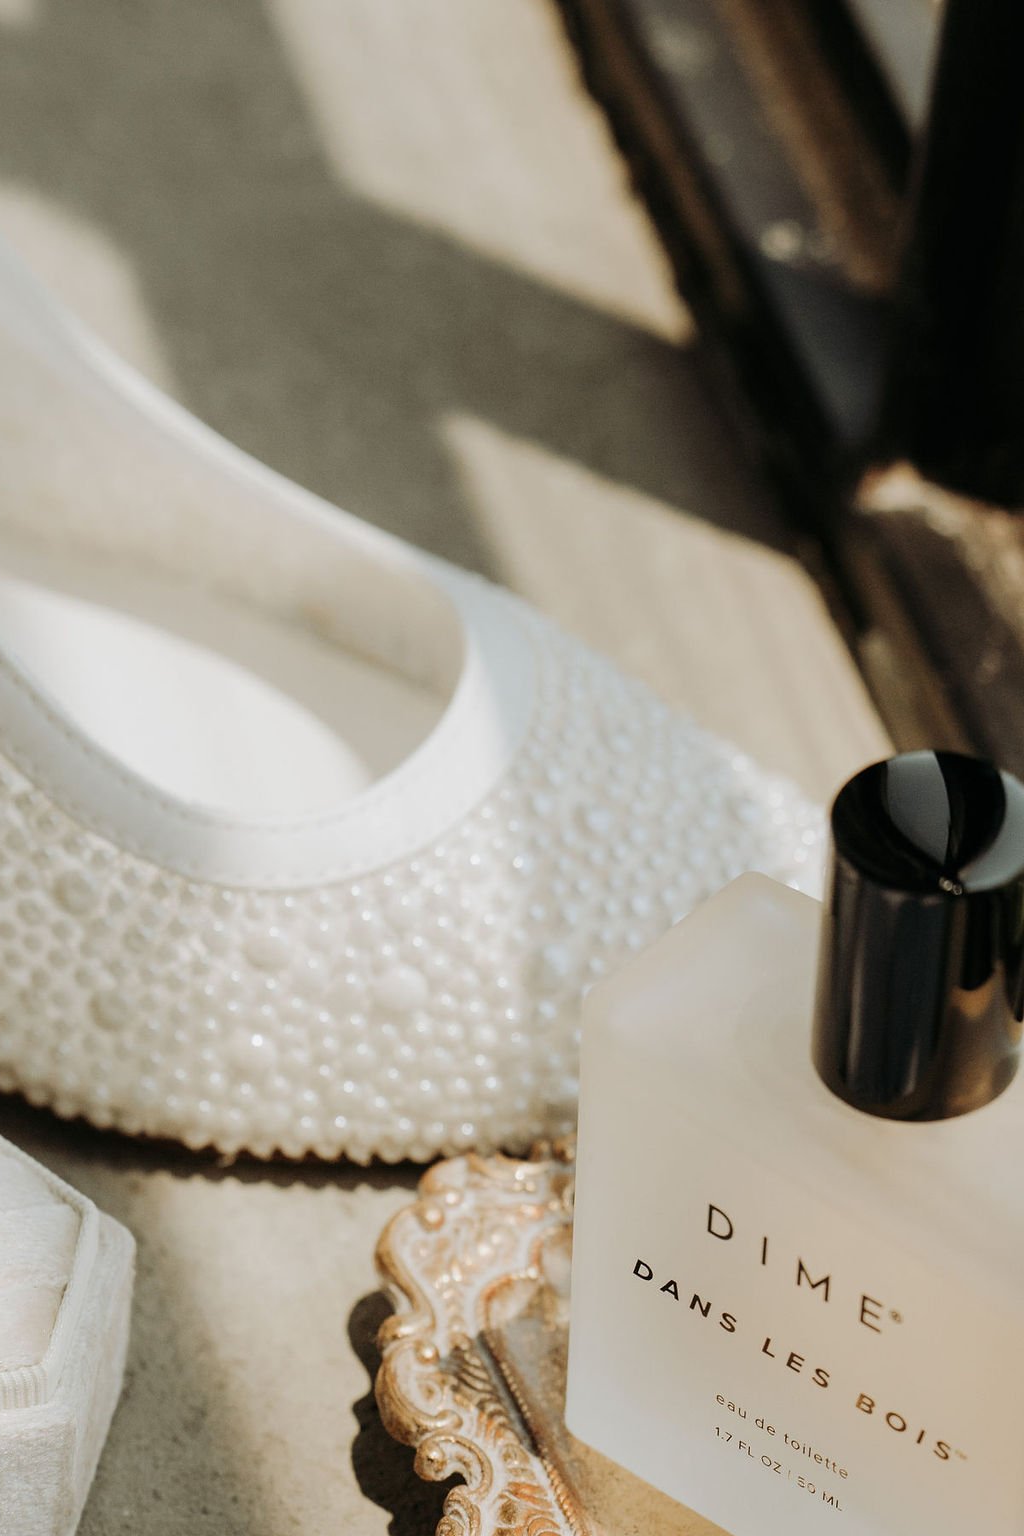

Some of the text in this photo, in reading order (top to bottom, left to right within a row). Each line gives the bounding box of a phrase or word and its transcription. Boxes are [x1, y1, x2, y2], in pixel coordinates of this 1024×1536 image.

[632, 1259, 738, 1333] DANS
[761, 1337, 830, 1388] LES
[714, 1426, 733, 1442] 1.7
[738, 1440, 755, 1458] FL
[761, 1455, 782, 1475] OZ
[797, 1476, 816, 1494] 50
[821, 1491, 843, 1512] ML
[716, 1394, 849, 1479] eau de toilette
